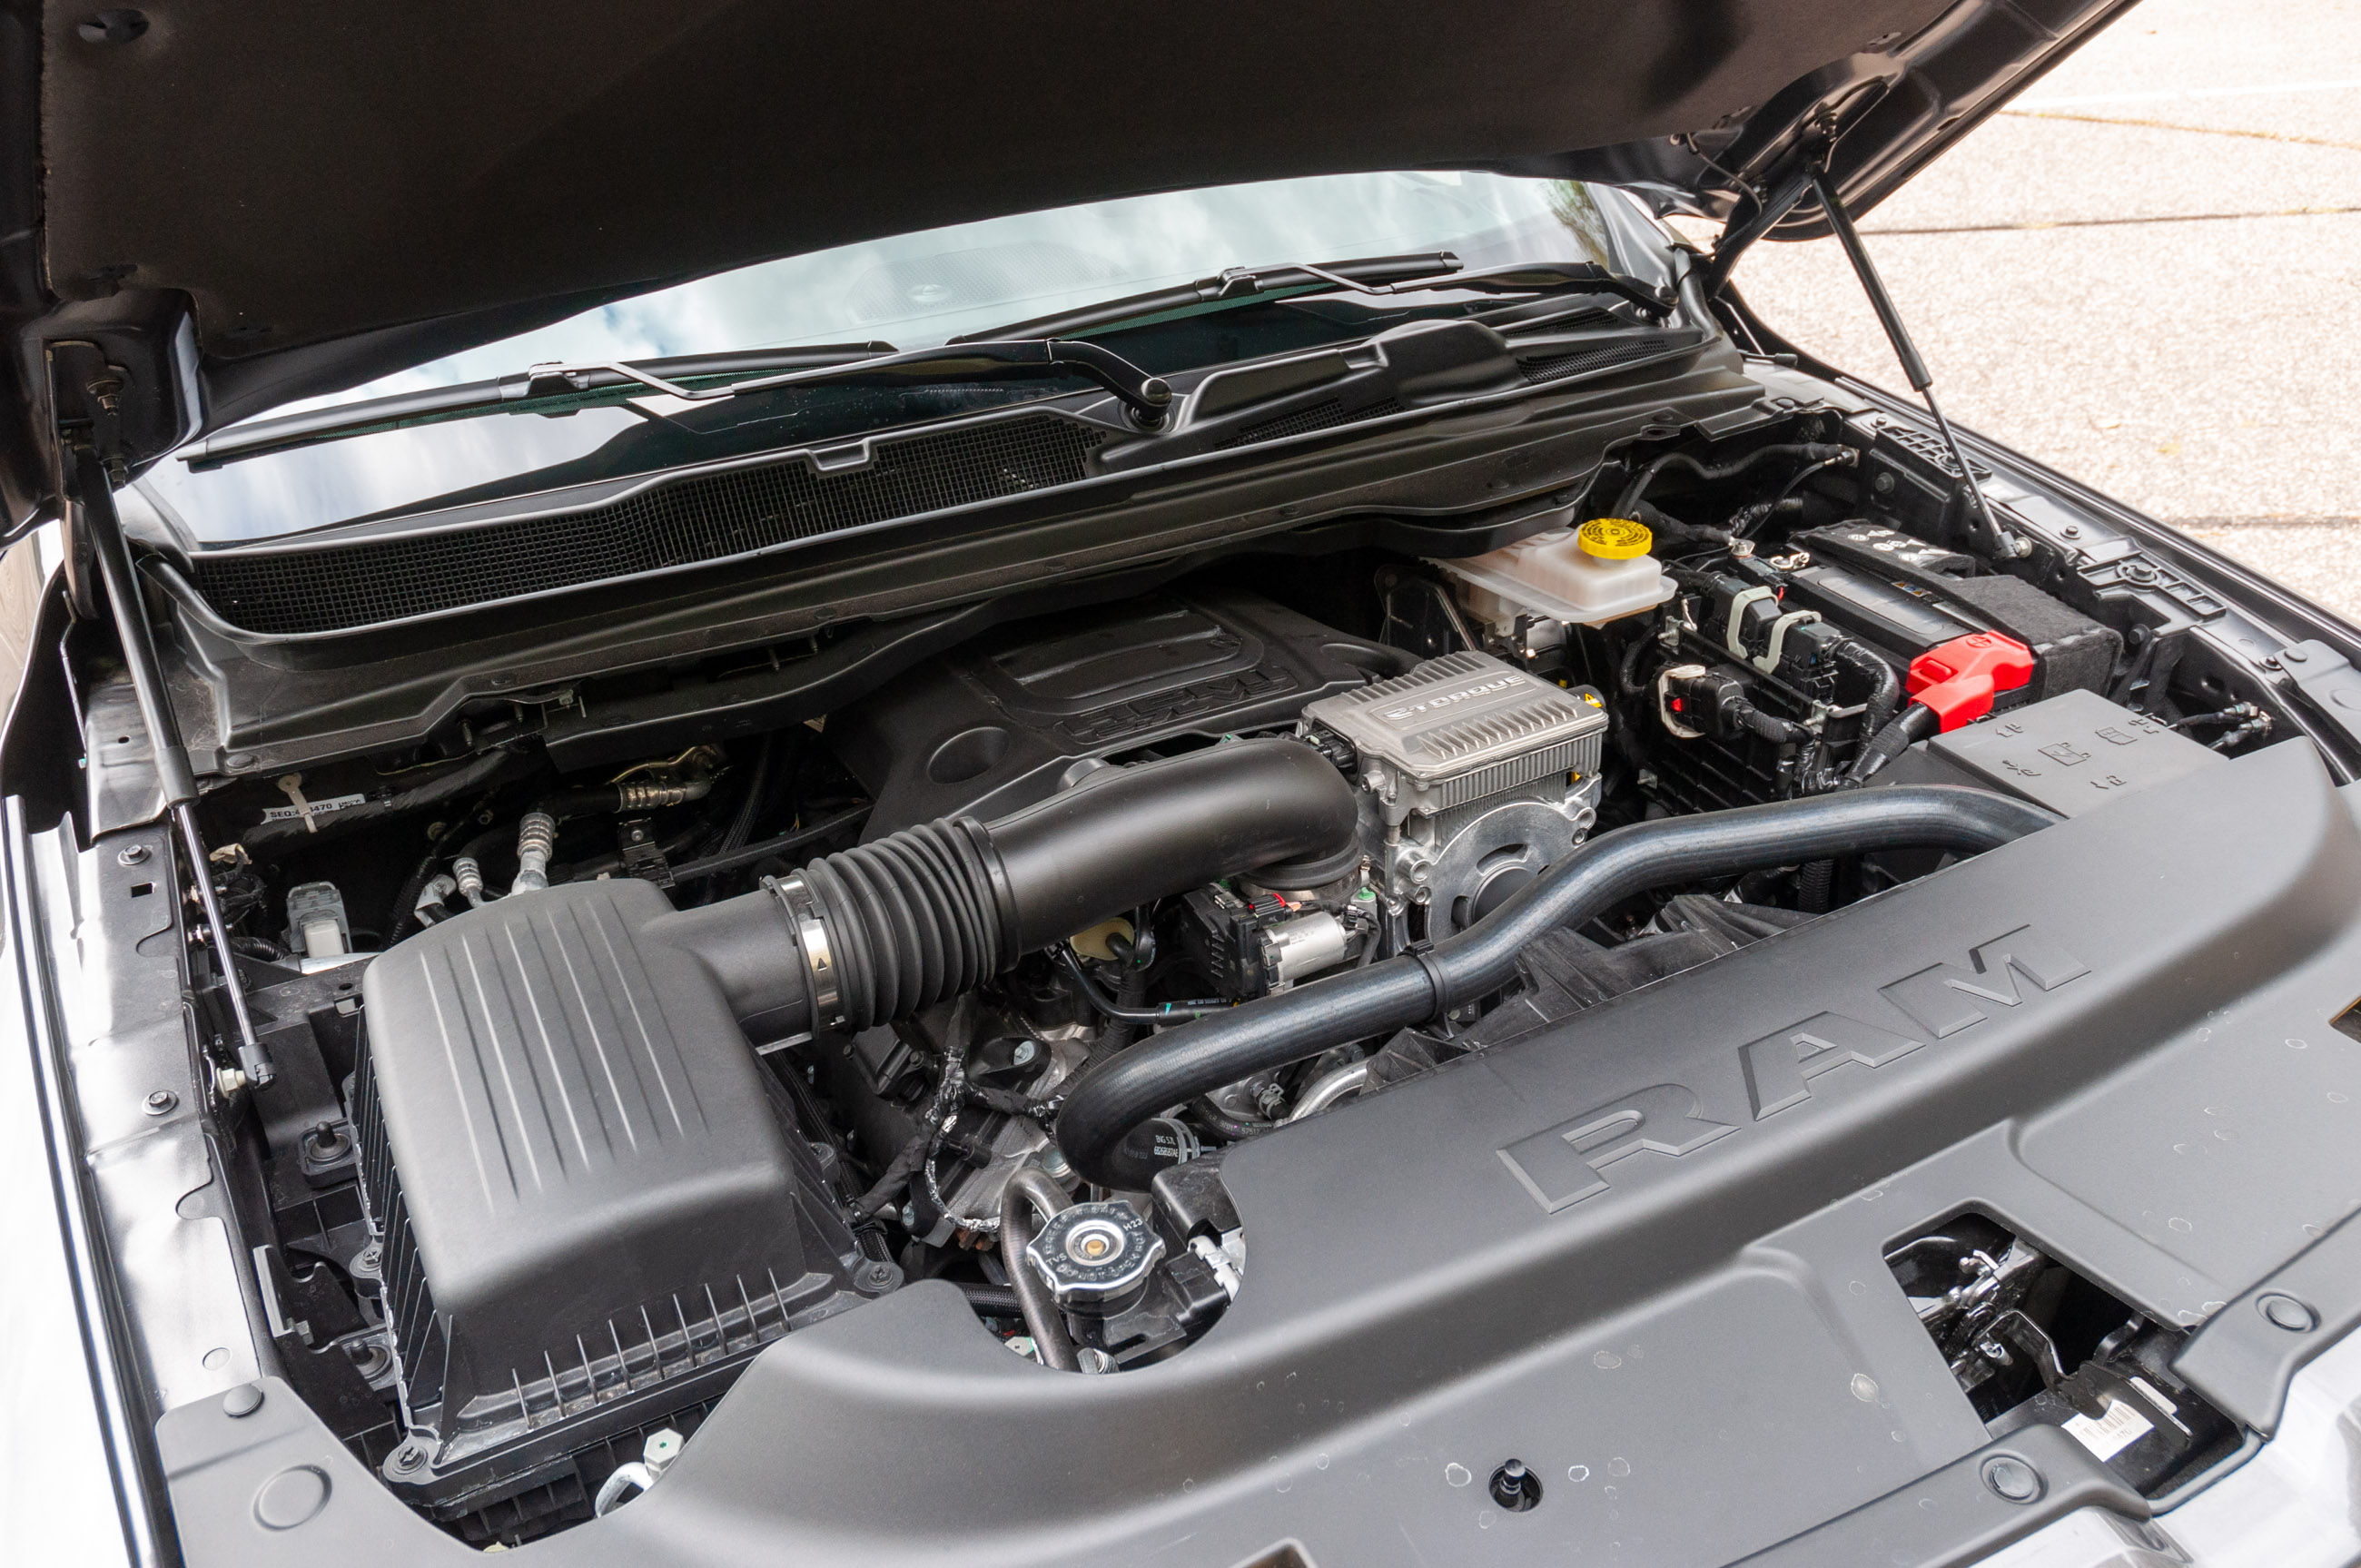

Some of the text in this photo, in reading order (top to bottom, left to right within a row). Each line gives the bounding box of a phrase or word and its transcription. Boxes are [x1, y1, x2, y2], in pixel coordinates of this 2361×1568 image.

[1062, 668, 1288, 736] HEMI
[1496, 923, 2091, 1214] RAM
[1122, 1218, 1143, 1231] H23
[1045, 1252, 1068, 1267] TVS
